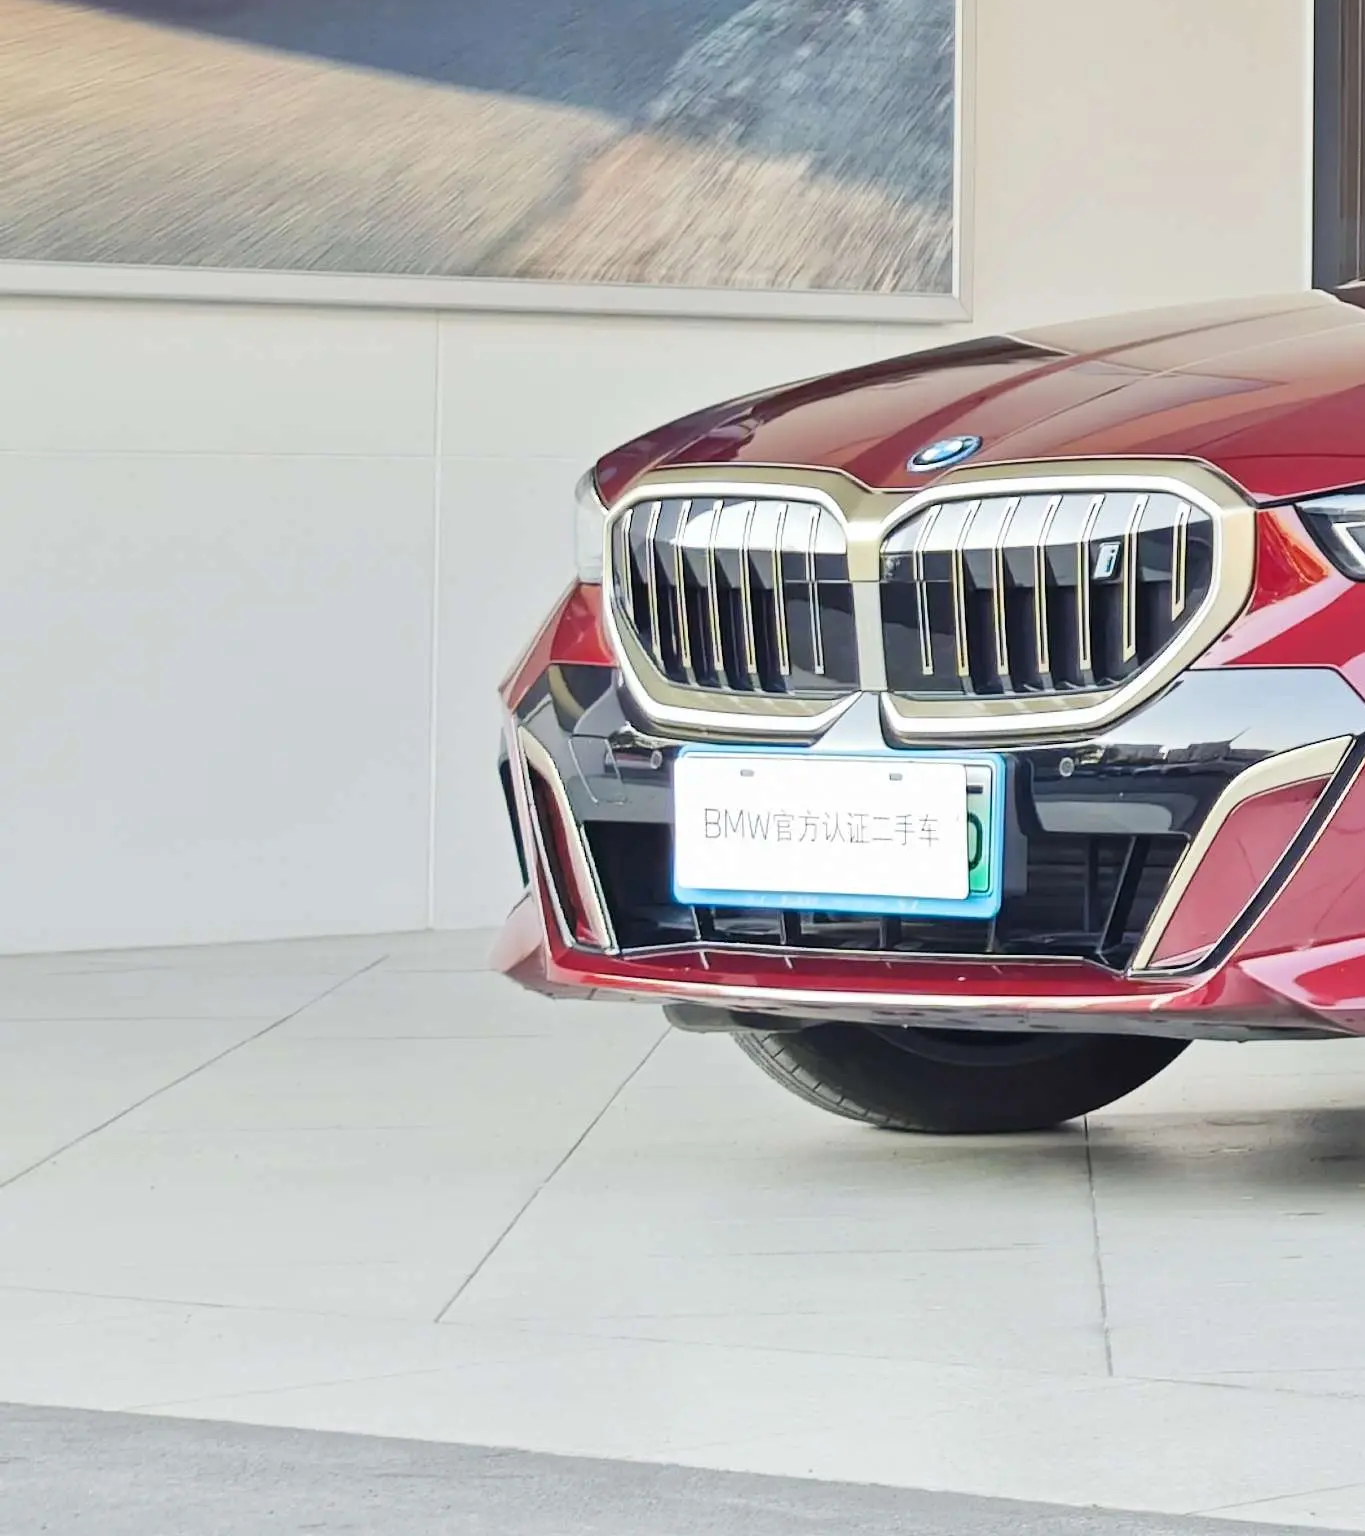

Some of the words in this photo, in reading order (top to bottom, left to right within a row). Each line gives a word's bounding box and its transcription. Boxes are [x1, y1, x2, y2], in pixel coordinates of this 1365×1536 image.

[704, 807, 939, 847] BMW官方认证二手车
